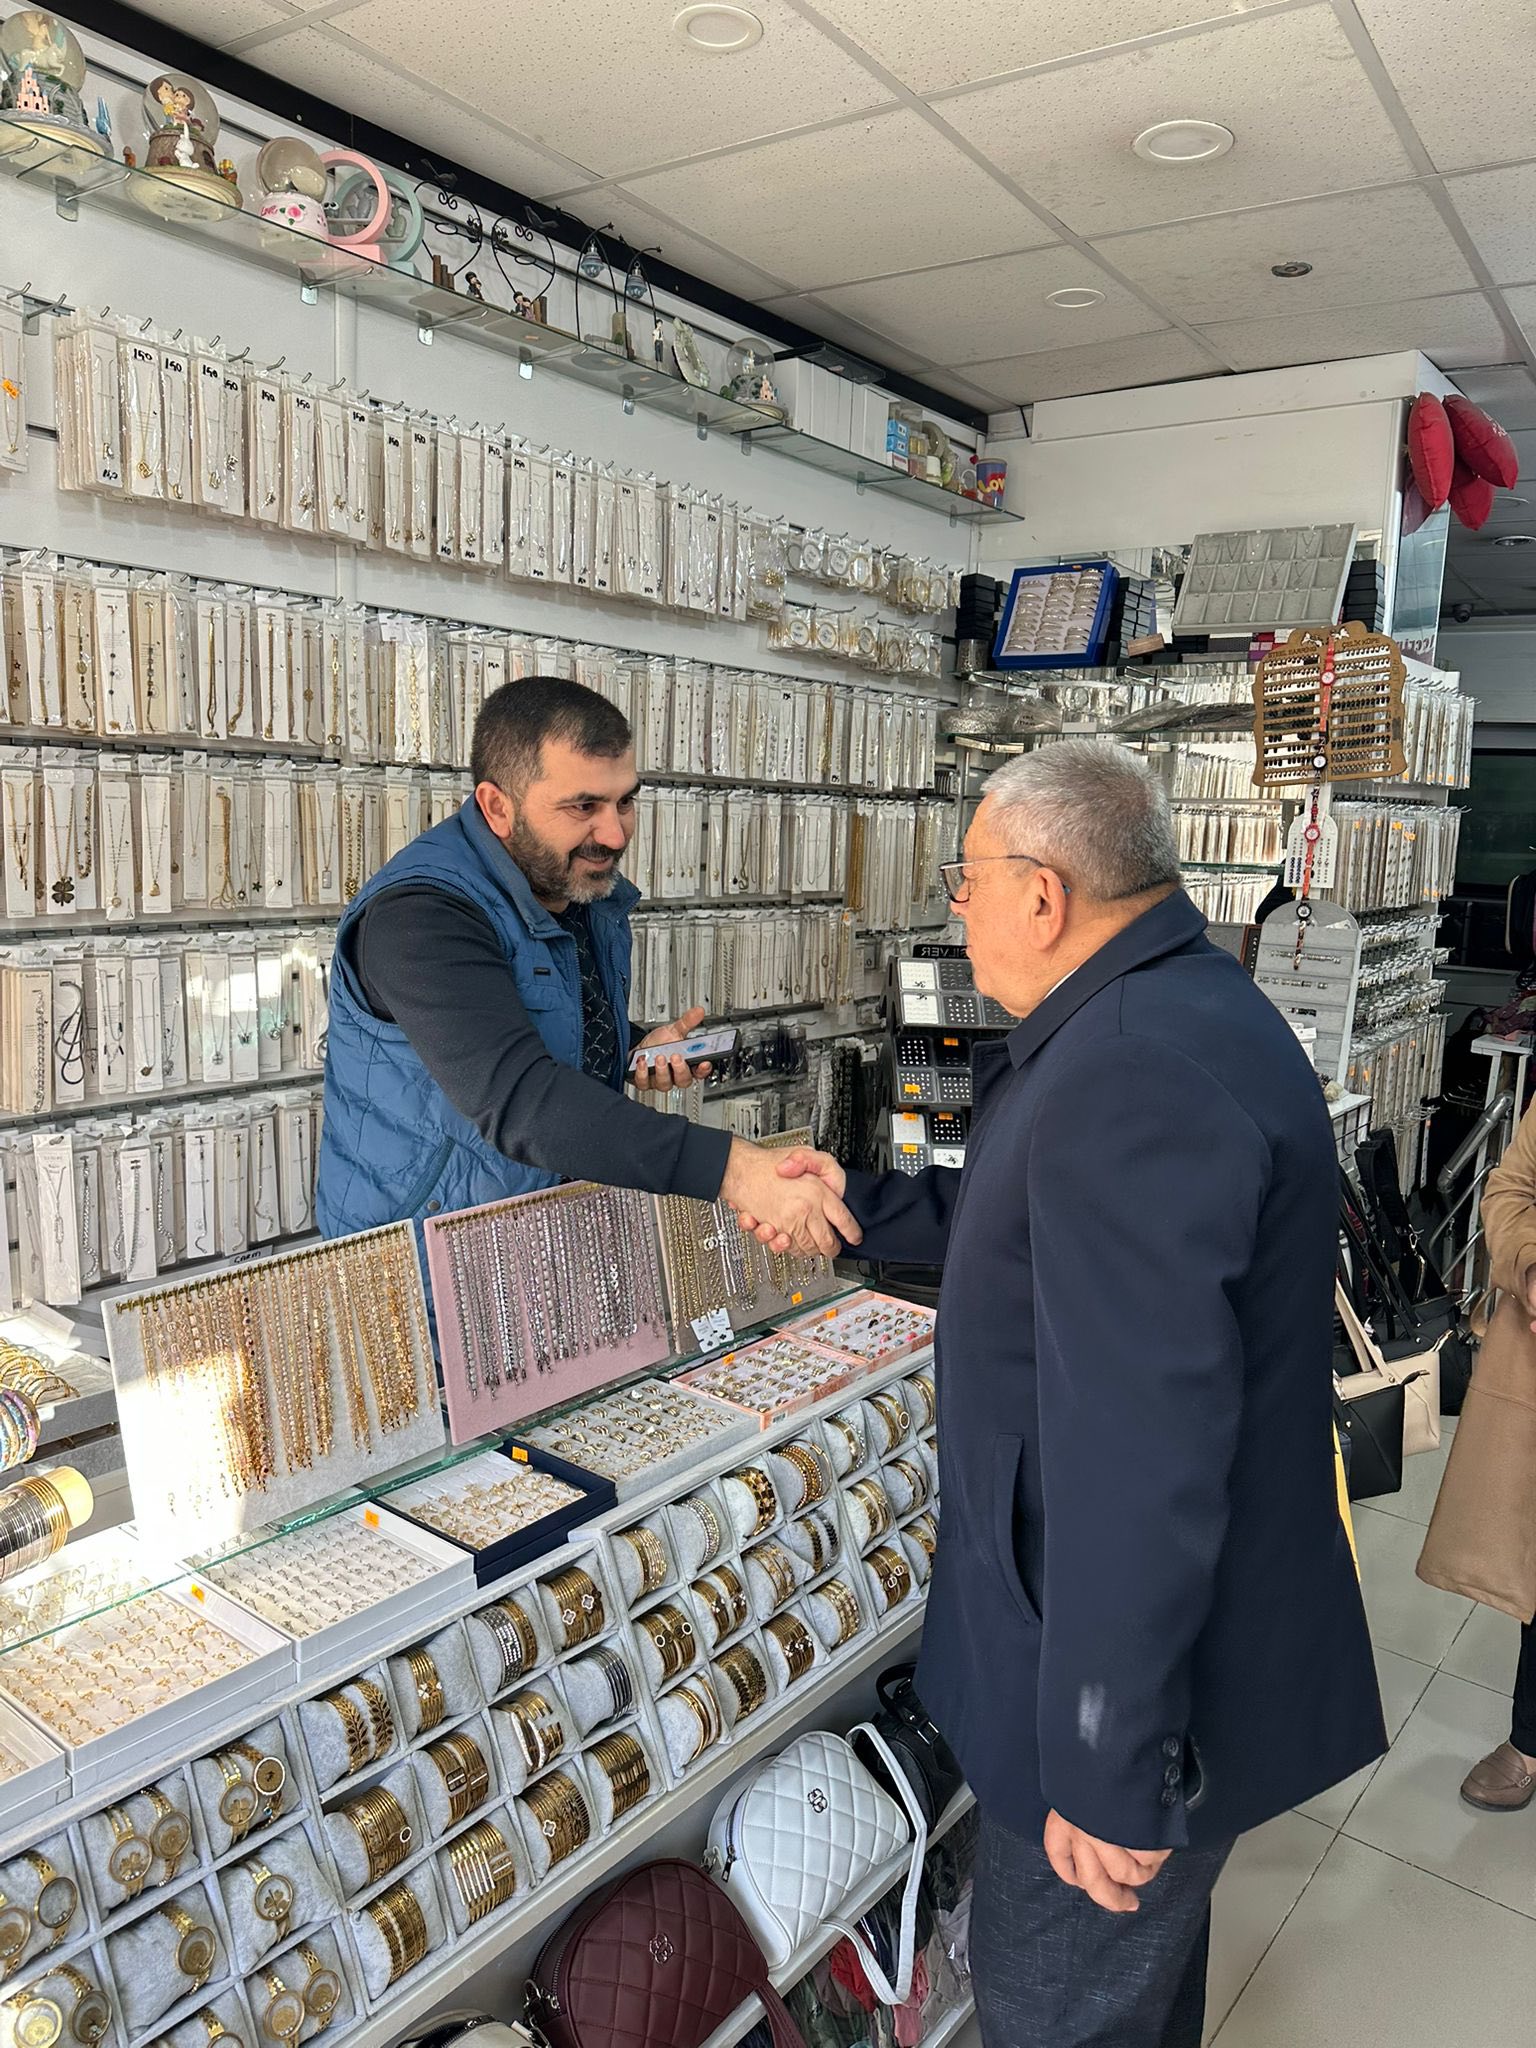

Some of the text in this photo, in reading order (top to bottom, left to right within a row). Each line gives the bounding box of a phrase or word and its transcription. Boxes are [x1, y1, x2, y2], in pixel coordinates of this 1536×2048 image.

[134, 348, 153, 361] 150
[165, 358, 182, 373] 150
[203, 365, 218, 379] 150
[262, 389, 276, 402] 150
[296, 397, 311, 410] 150
[353, 411, 366, 422] 150
[489, 445, 501, 456] 150
